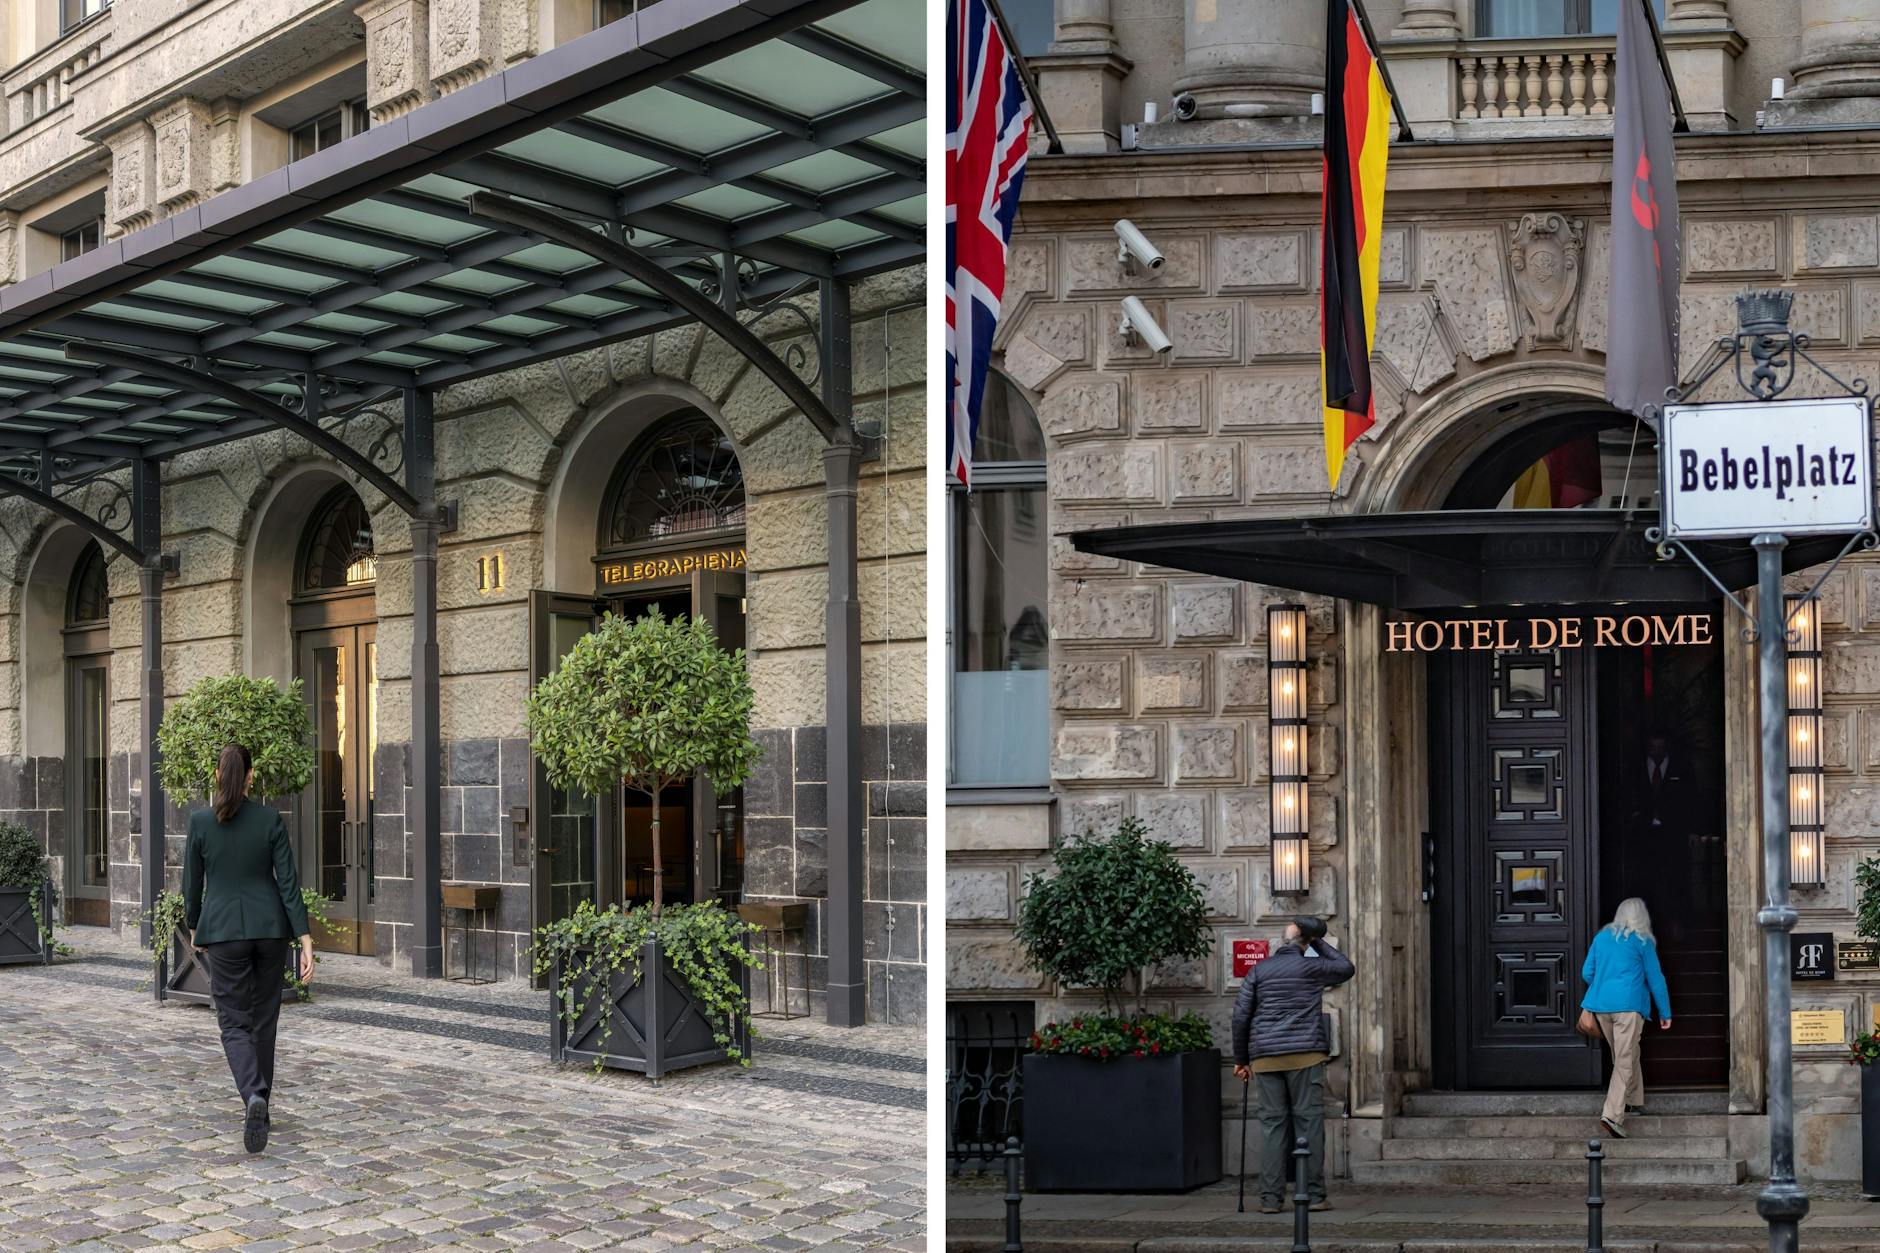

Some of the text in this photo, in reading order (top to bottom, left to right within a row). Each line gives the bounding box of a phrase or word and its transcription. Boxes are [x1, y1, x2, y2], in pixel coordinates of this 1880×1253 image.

[1679, 444, 1857, 499] Bebelplatz
[476, 552, 504, 592] 11
[1385, 614, 1713, 652] HOTEL DE ROME
